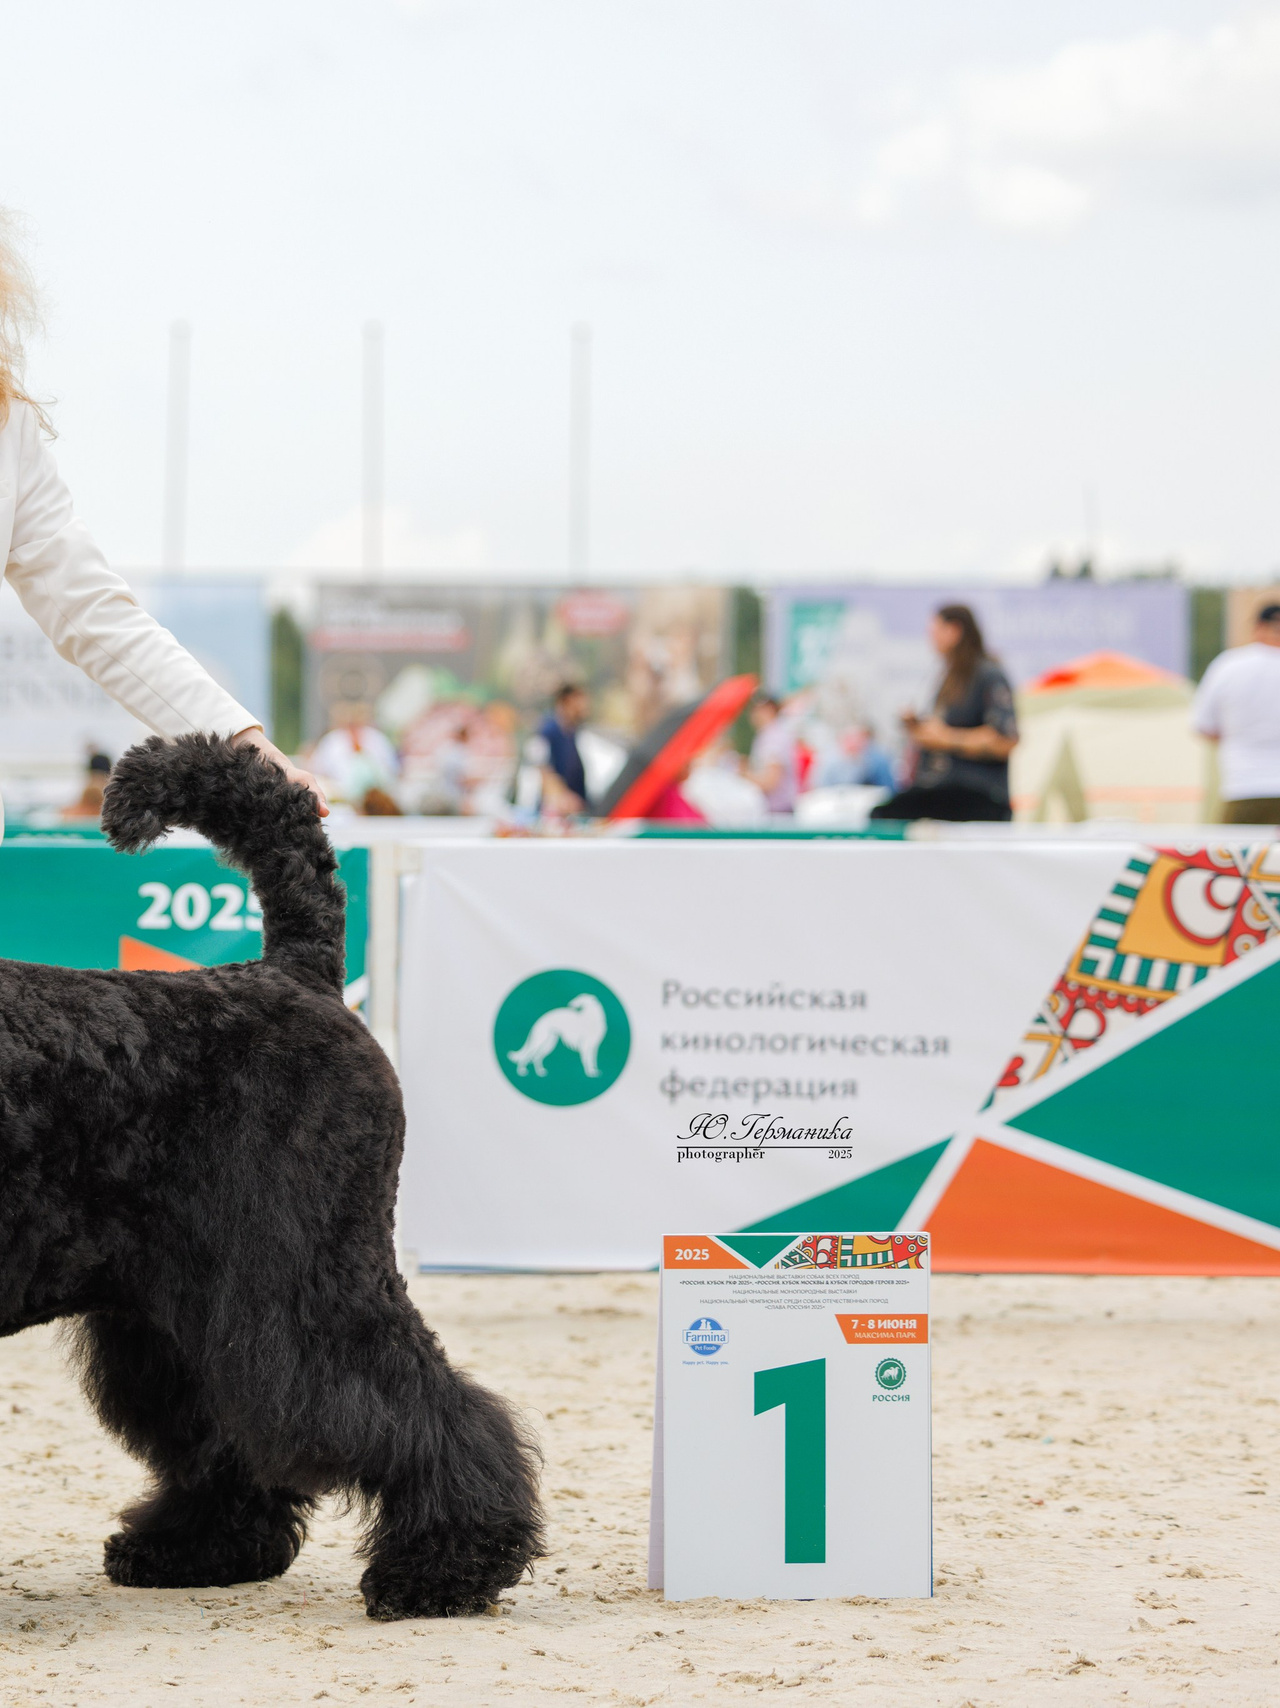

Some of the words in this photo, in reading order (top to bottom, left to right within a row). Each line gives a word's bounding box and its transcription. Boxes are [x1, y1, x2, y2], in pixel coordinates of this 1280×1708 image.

[661, 979, 868, 1010] Российская
[660, 1030, 951, 1056] кинологическая
[659, 1066, 859, 1106] федерация
[675, 1248, 710, 1260] 2025
[686, 1332, 726, 1342] Farmina
[851, 1319, 859, 1329] 7
[868, 1319, 876, 1329] 8
[878, 1319, 917, 1329] ИЮНЯ
[754, 1358, 826, 1564] 1
